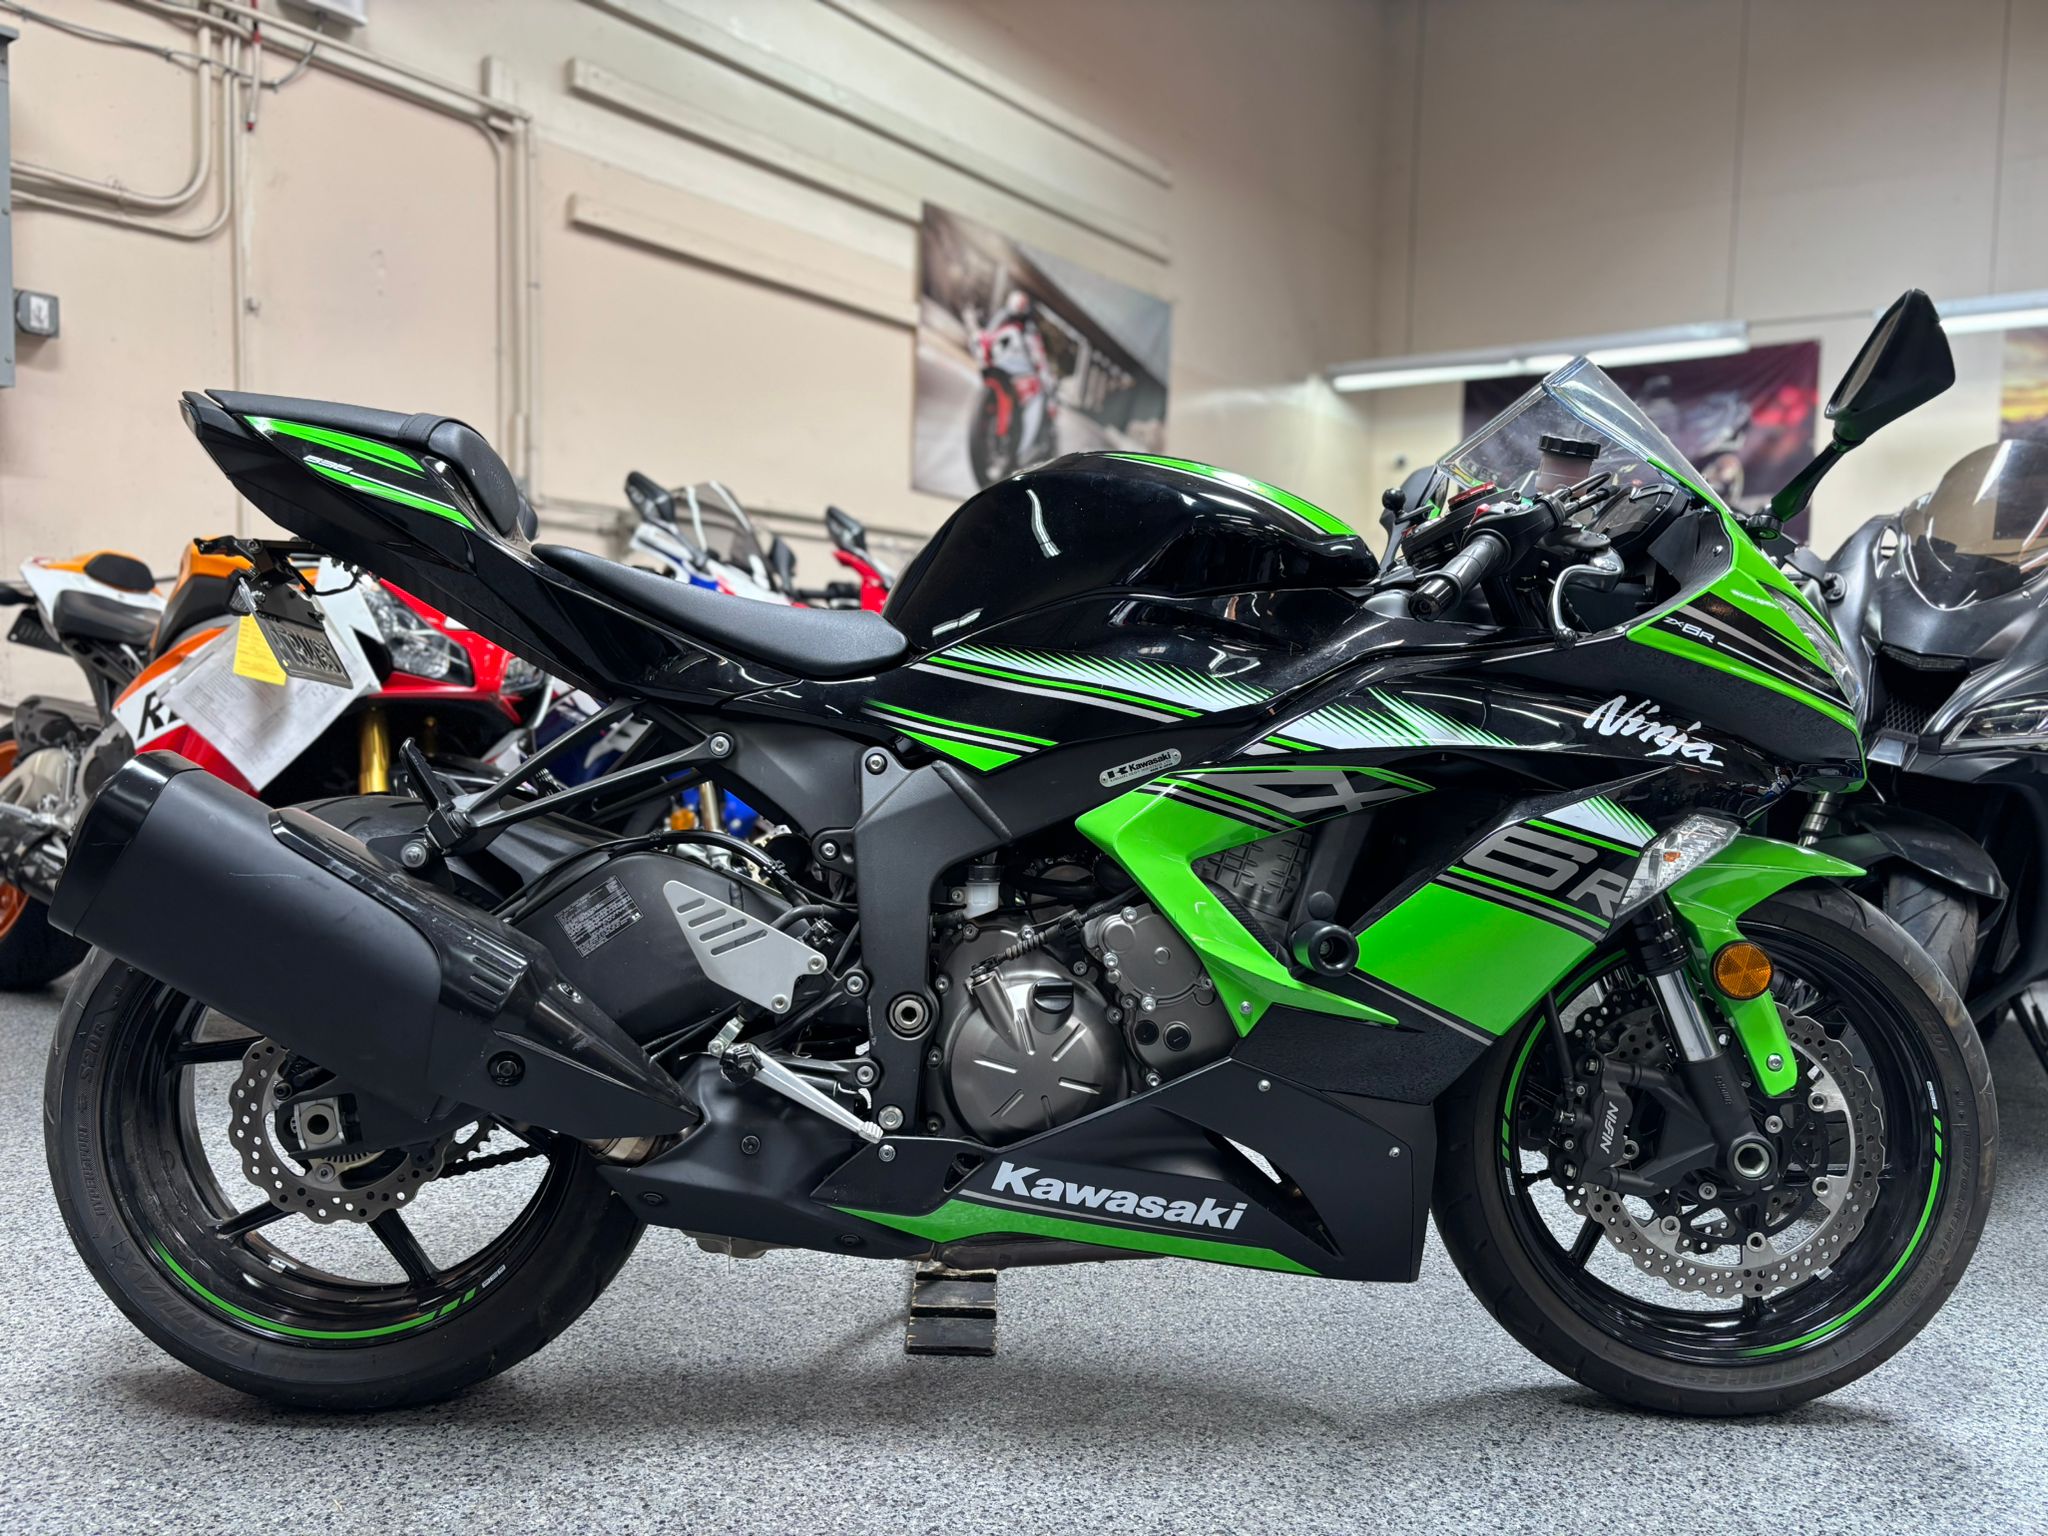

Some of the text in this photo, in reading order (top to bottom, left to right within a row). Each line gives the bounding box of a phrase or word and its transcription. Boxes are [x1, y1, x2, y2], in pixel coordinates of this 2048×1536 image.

[1128, 752, 1171, 771] Kawasaki
[1583, 695, 1724, 766] Ninja
[1462, 825, 1629, 920] 6R
[991, 1161, 1248, 1230] Kawasaki
